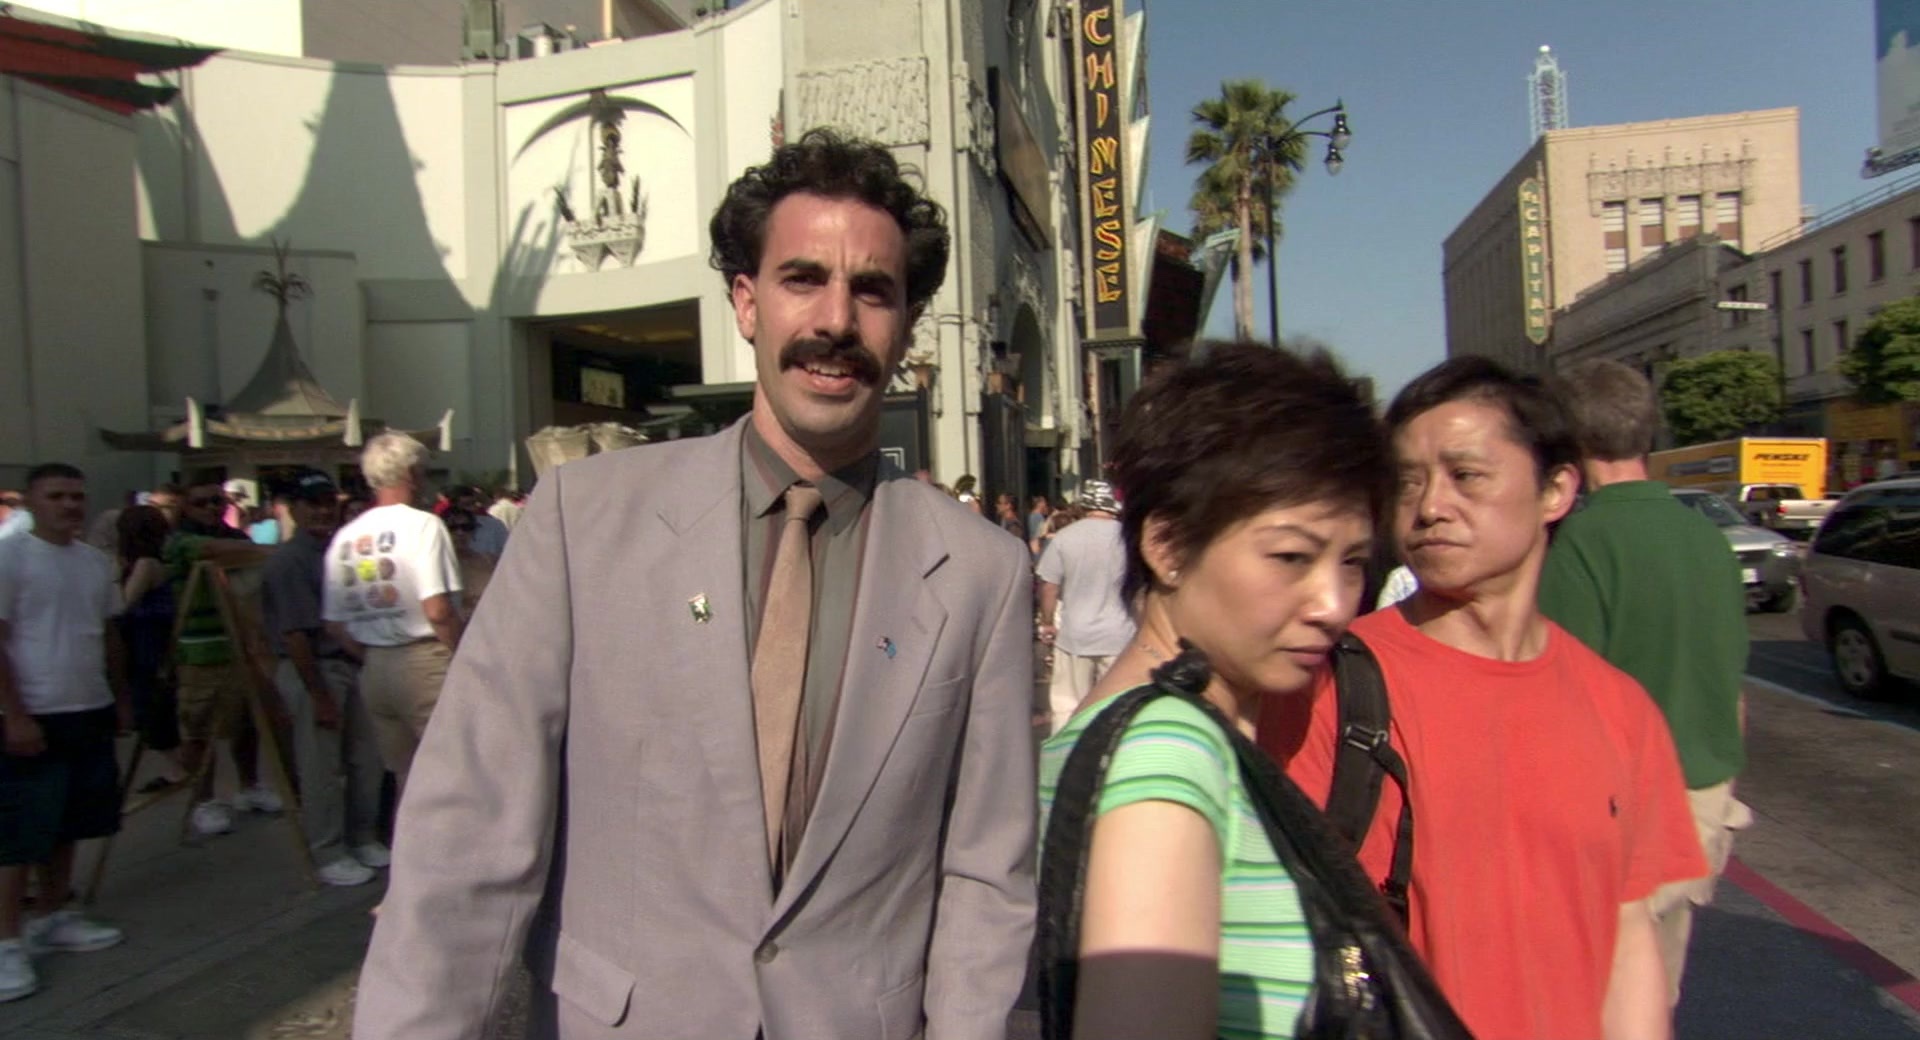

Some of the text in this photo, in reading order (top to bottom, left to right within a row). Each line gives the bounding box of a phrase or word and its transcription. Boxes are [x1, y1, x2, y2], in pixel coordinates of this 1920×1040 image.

[1084, 8, 1122, 303] CHINESE
[1525, 208, 1544, 329] CAPITAN
[1753, 453, 1810, 461] PENSKE
